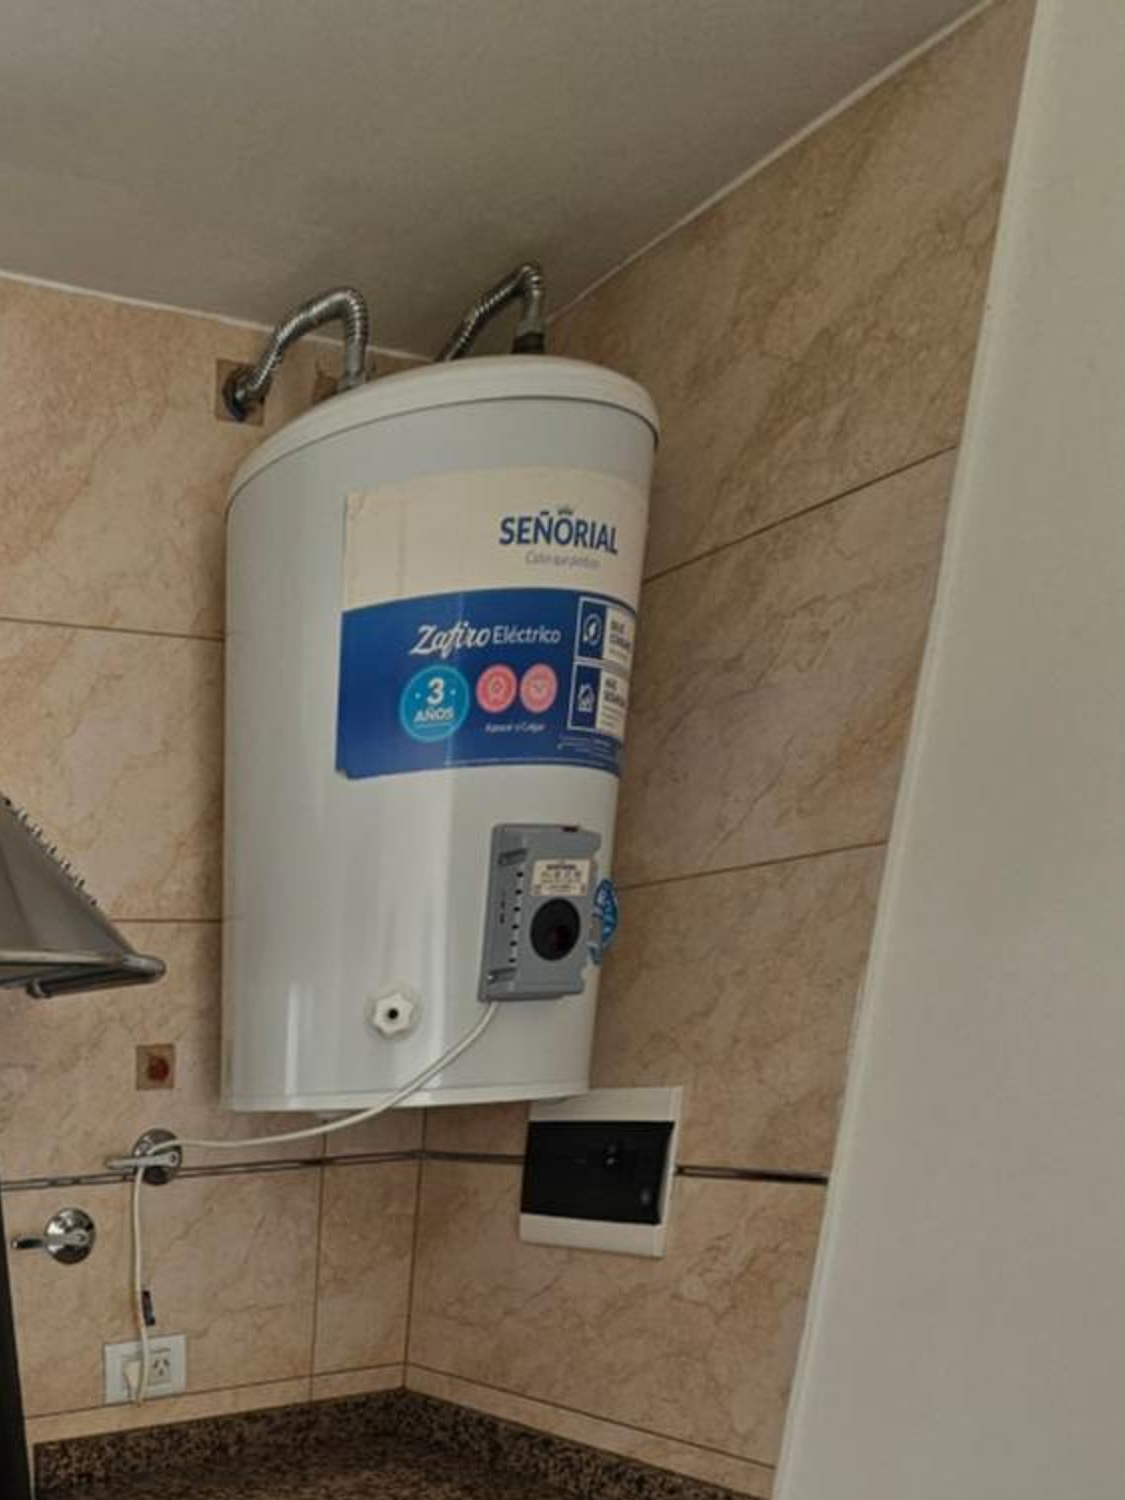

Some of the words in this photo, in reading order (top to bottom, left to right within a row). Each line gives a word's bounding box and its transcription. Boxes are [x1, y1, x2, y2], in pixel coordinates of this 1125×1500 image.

[499, 510, 618, 555] SEÑORIAL
[409, 620, 491, 659] Zafiro
[493, 624, 561, 643] Eléctrico
[426, 677, 445, 705] 3
[413, 706, 455, 723] AÑOS
